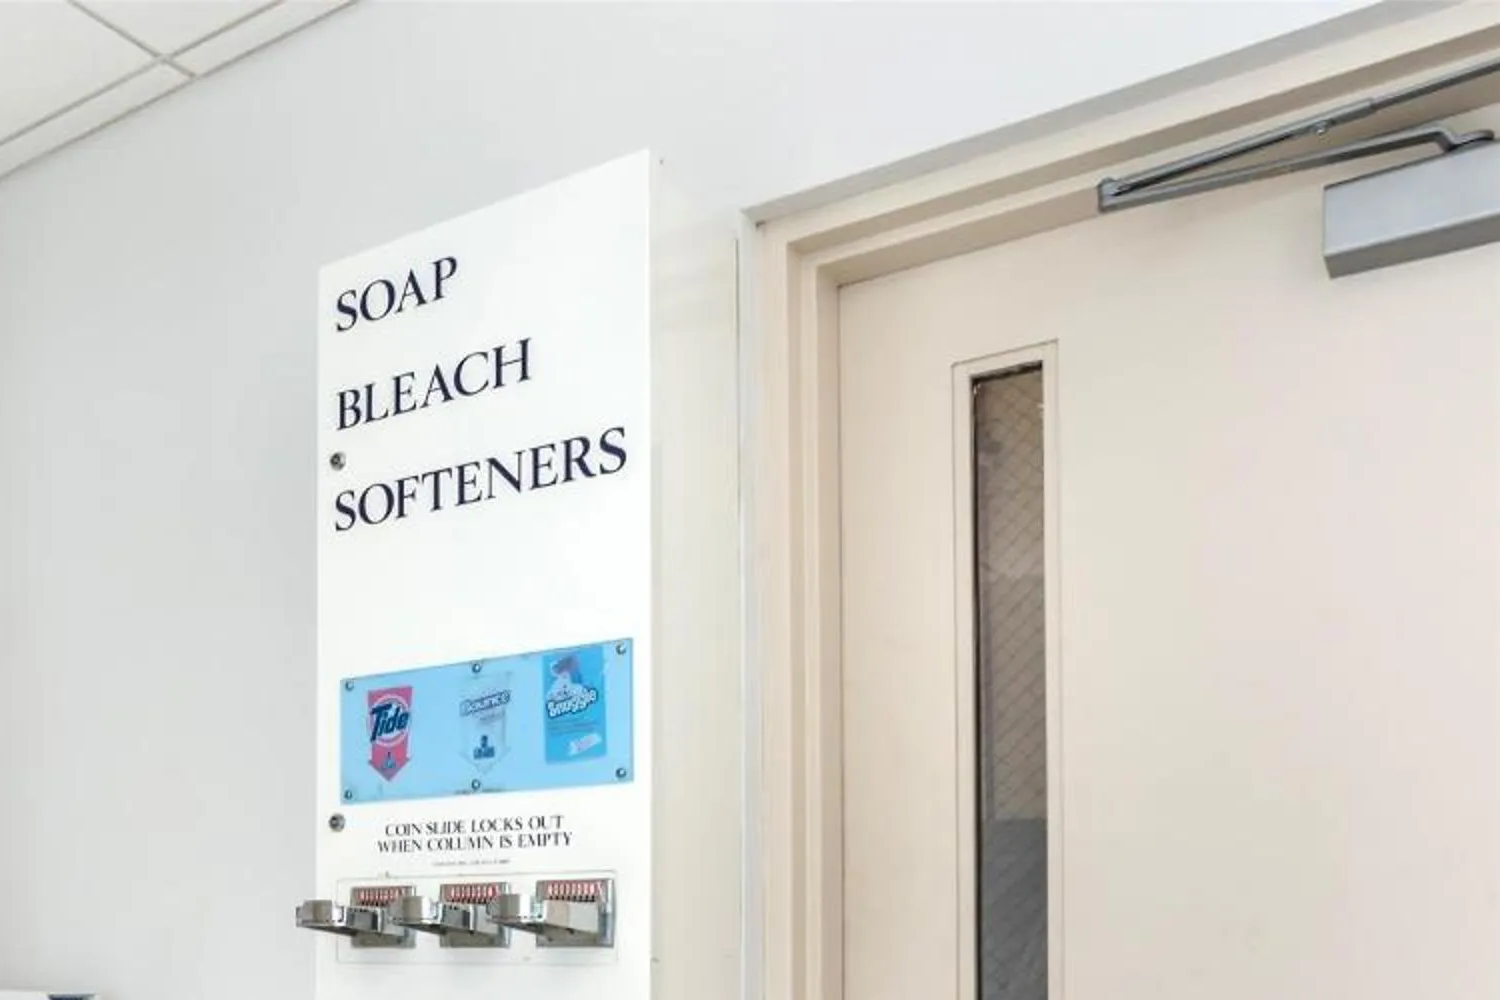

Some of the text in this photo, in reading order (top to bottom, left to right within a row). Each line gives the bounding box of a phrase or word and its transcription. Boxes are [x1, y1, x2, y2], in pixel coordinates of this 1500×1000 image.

[335, 256, 457, 332] SOAP
[336, 337, 532, 431] BLEACH
[334, 426, 628, 532] SOFTENERS
[370, 703, 410, 743] Tide
[377, 831, 573, 854] WHEN COLUMN IS EMPTY
[385, 814, 565, 838] COIN SLIDE LOCKS OUT
